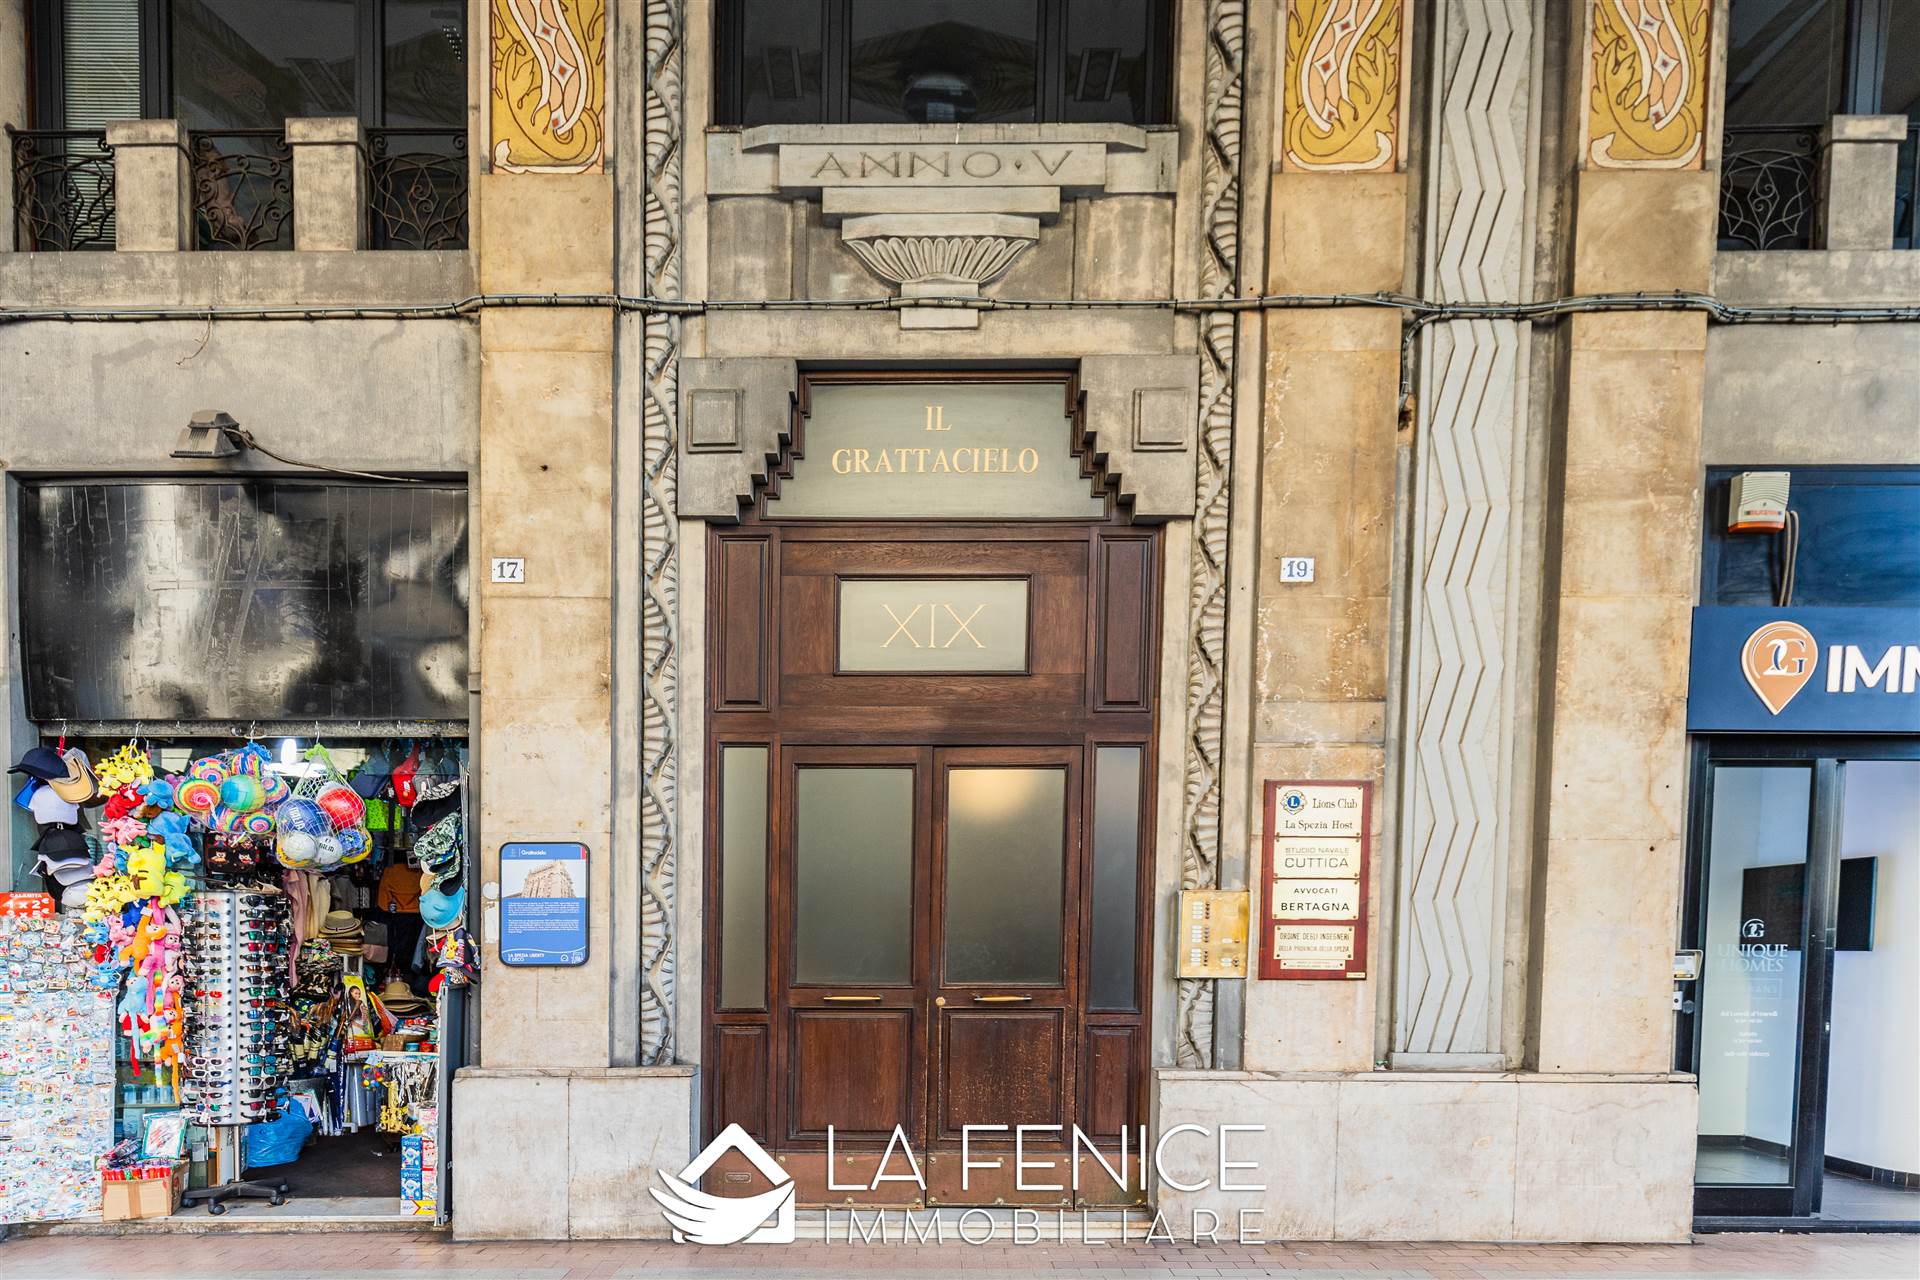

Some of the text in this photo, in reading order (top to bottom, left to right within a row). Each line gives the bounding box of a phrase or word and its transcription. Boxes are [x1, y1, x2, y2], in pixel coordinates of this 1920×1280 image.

[925, 405, 952, 431] IL
[831, 447, 1039, 474] GRATTACIELO
[498, 561, 518, 578] 17
[1287, 560, 1307, 577] 19
[880, 603, 987, 648] XIX
[1312, 798, 1358, 809] Lions Club
[1285, 820, 1353, 831] La Spezia Host
[1284, 857, 1349, 868] CUTTICA
[1281, 902, 1350, 912] BERTAGNA
[1717, 943, 1789, 961] UNIQUE
[1721, 959, 1784, 972] HOMES
